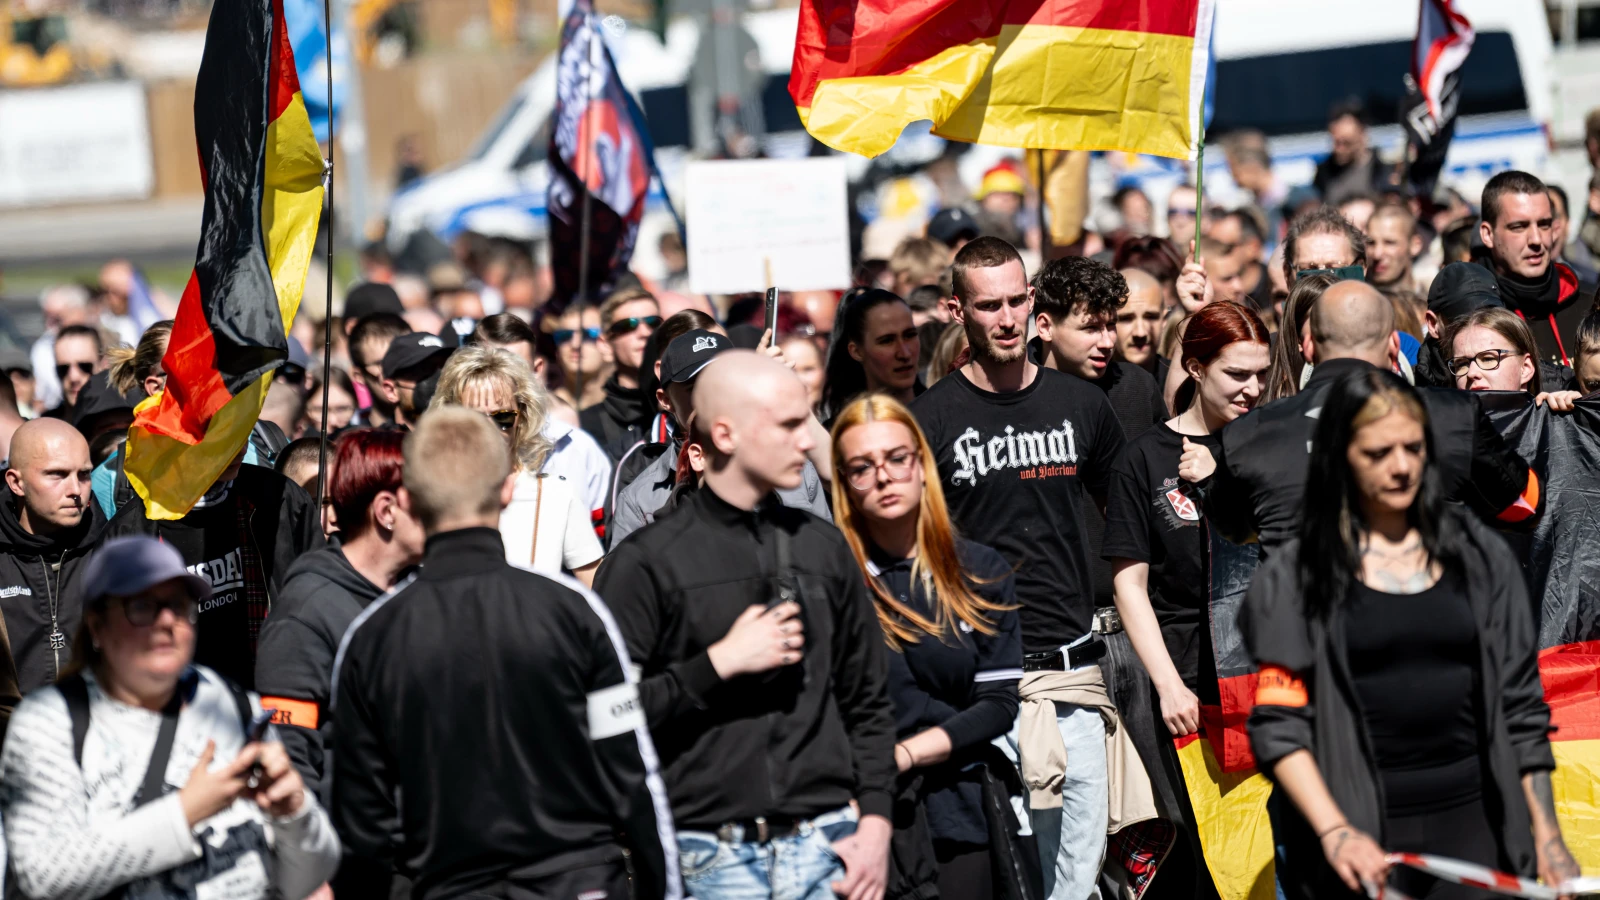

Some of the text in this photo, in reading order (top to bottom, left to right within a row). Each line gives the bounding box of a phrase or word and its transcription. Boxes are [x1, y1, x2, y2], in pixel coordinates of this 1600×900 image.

[951, 419, 1078, 487] Heimat
[1020, 465, 1077, 480] und Vaterland
